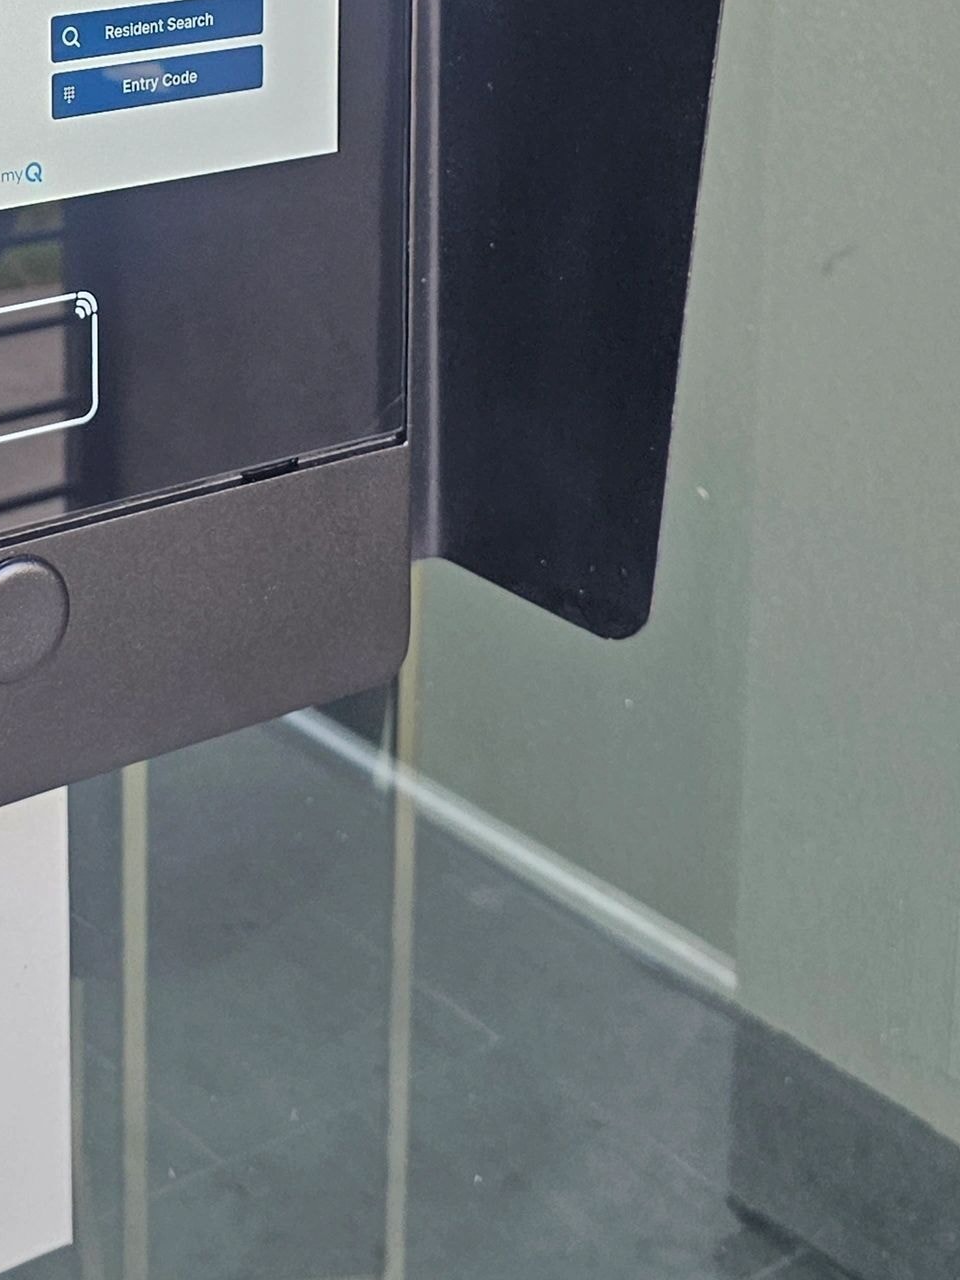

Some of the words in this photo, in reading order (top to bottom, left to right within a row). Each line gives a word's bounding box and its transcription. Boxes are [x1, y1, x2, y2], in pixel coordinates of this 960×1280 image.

[104, 19, 164, 40] Resident
[167, 13, 214, 31] Search
[122, 76, 159, 94] Entry
[162, 70, 198, 87] Code
[1, 162, 43, 185] myQ
